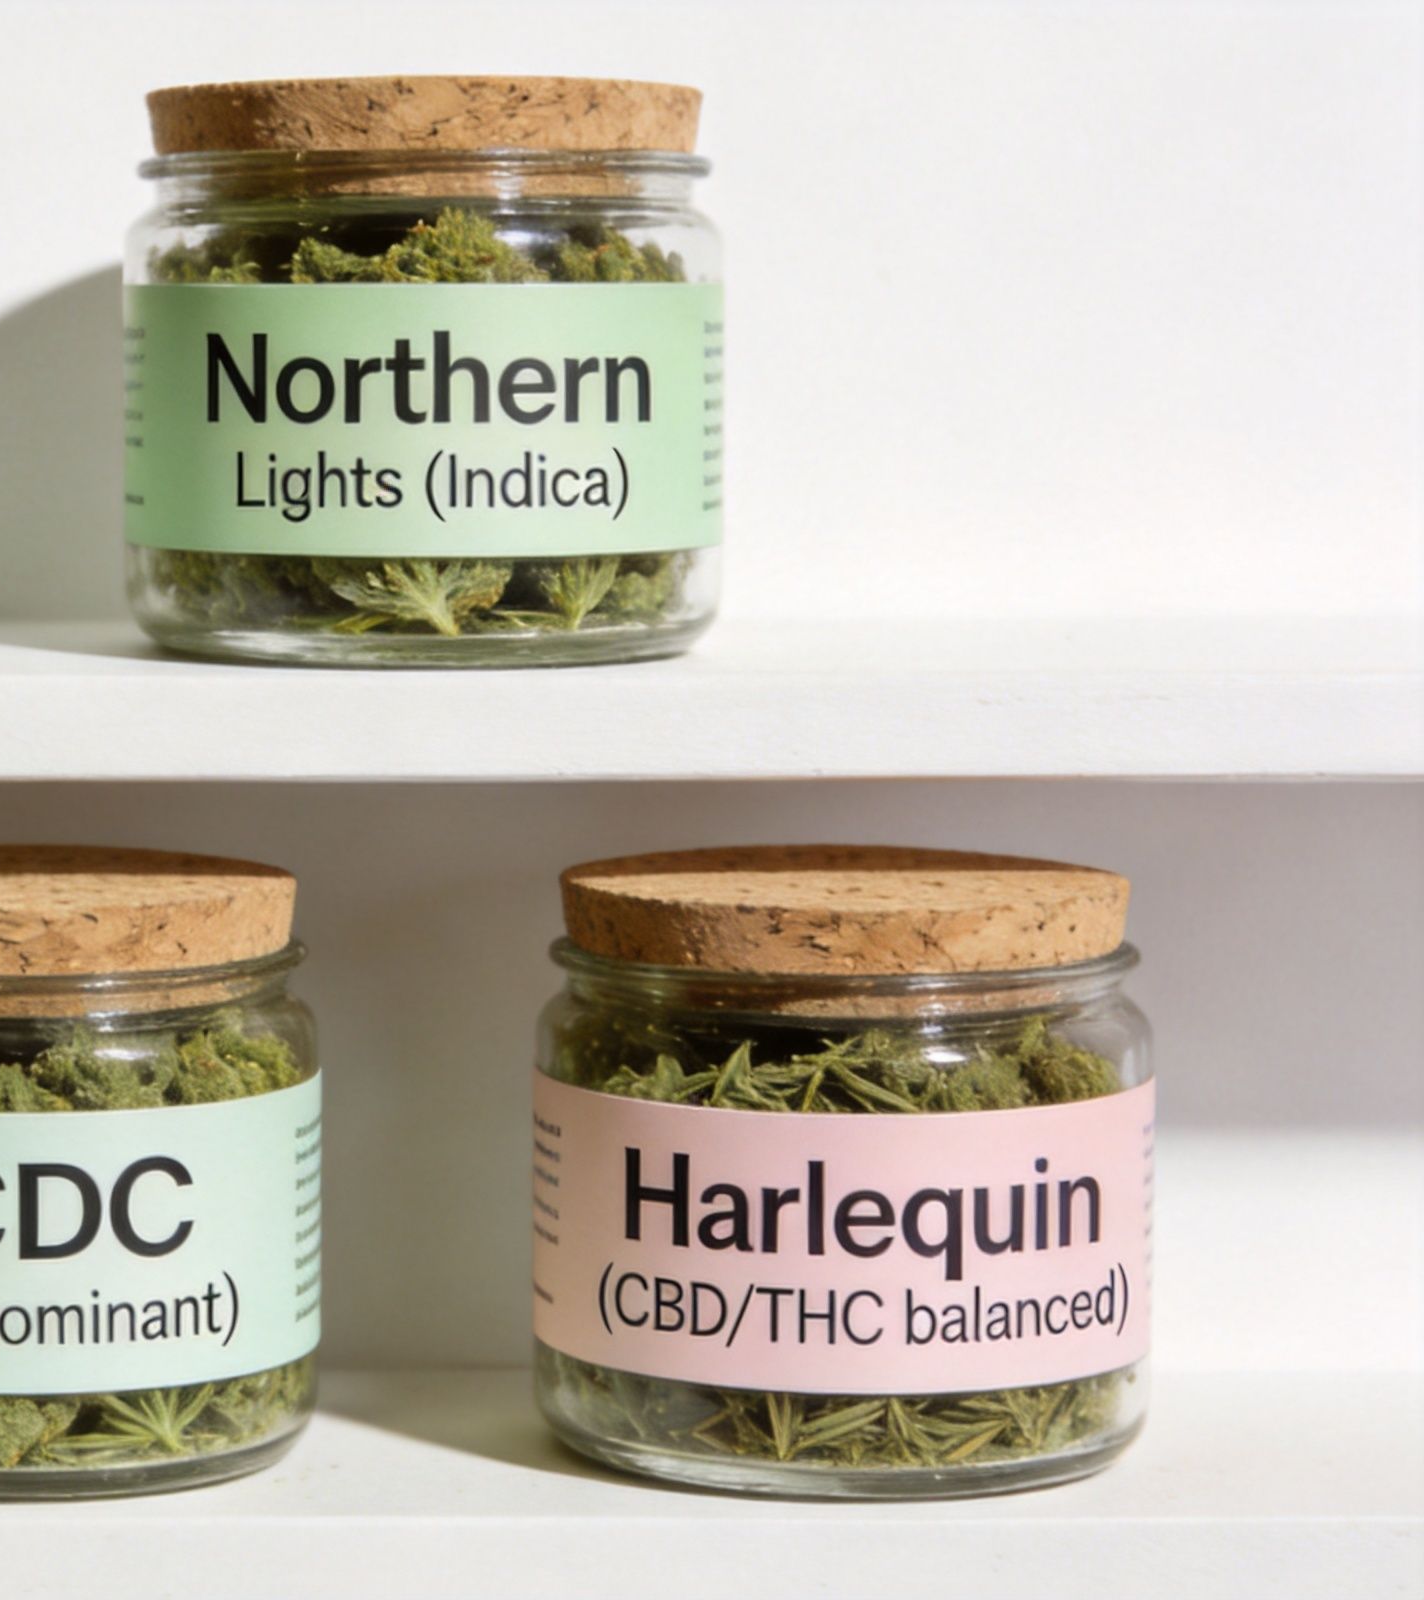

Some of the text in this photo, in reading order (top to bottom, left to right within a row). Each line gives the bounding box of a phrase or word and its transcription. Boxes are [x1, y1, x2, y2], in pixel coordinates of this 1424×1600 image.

[205, 329, 652, 425] Northern
[235, 447, 629, 522] Lights (Indica)
[623, 1145, 1101, 1280] Harlequin
[597, 1261, 1128, 1348] (CBD/THC balanced)
